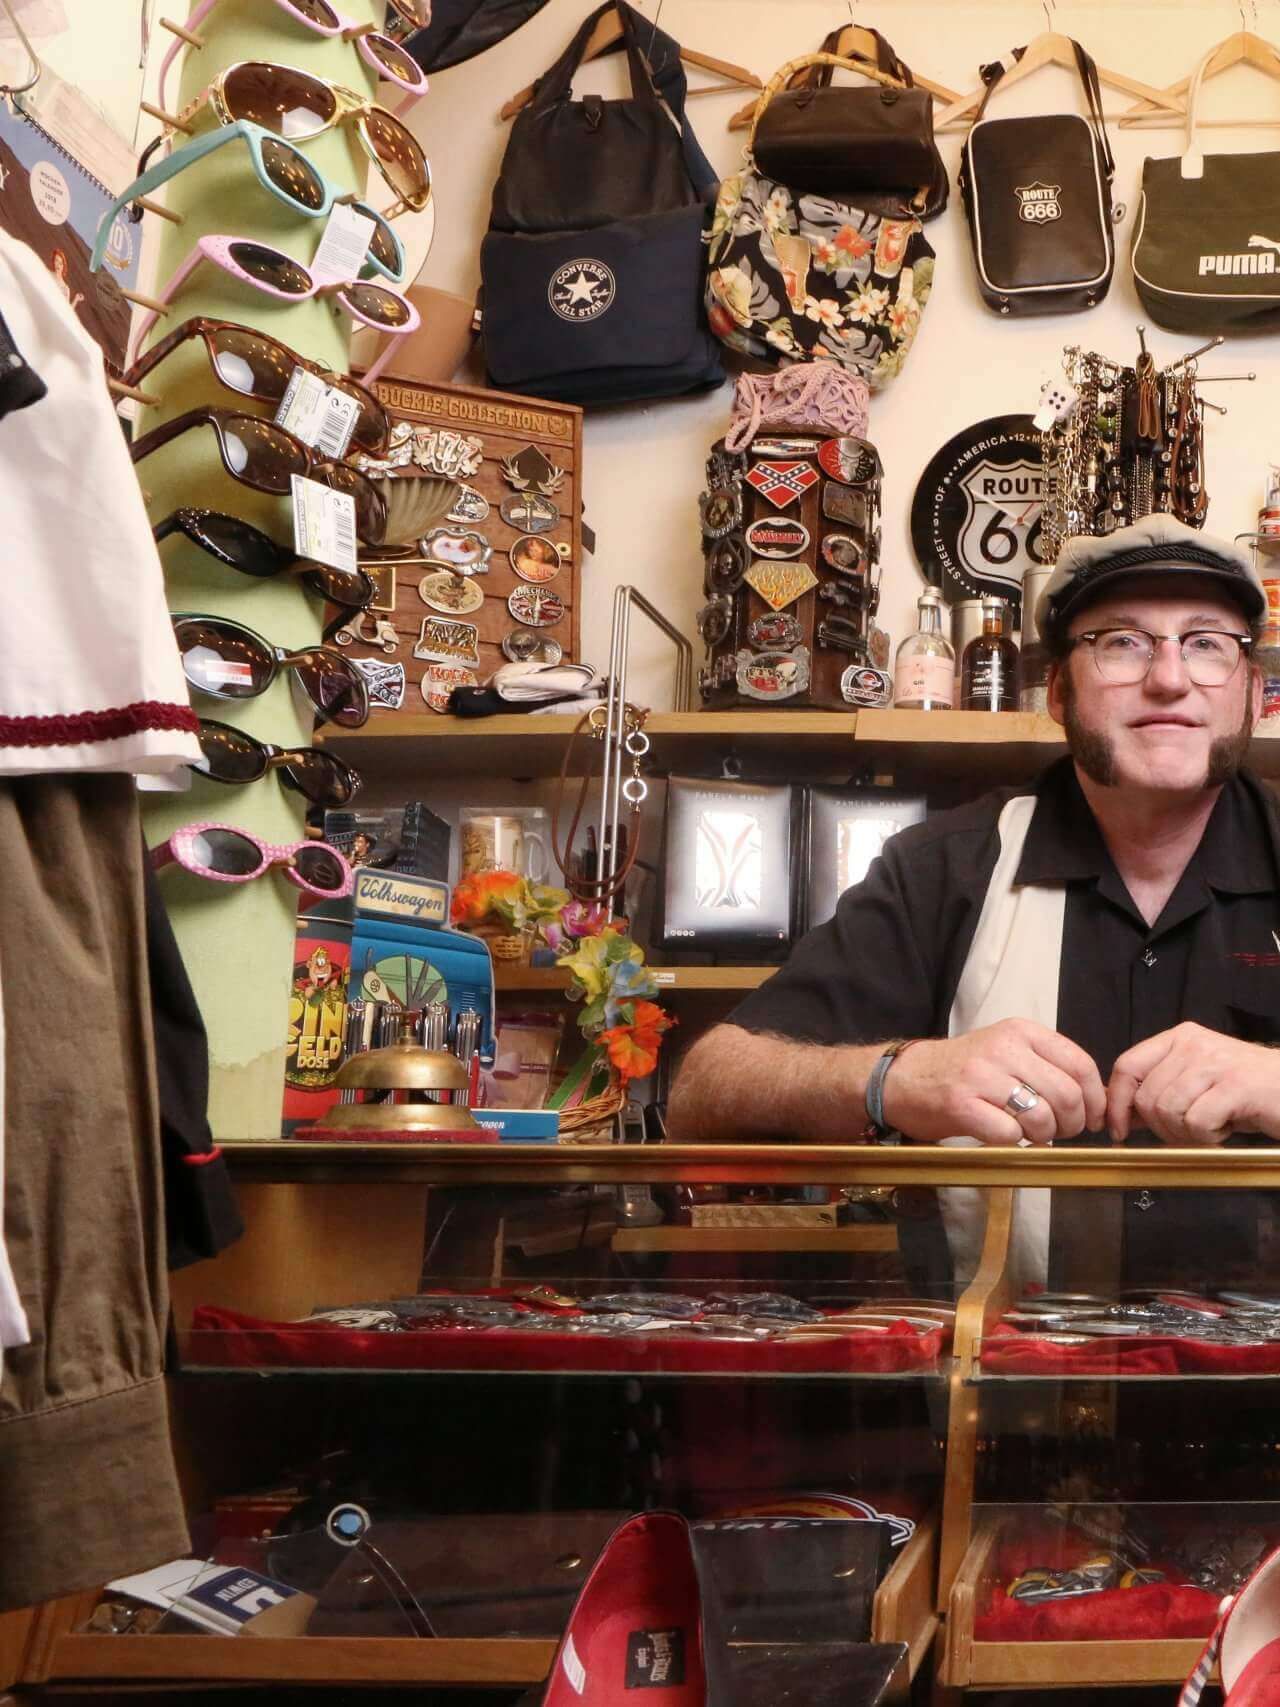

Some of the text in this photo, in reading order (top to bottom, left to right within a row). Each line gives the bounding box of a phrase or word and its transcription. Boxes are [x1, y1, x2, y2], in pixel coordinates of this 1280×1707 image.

[1022, 189, 1055, 201] ROUTE
[1024, 203, 1058, 220] 666
[1199, 252, 1275, 276] PUMA
[556, 263, 608, 285] CONVERSE
[559, 300, 604, 317] ALL STAR
[378, 384, 544, 432] BUCKLE COLLECTION
[1014, 433, 1025, 442] 12
[956, 434, 1008, 468] AMERICA
[934, 485, 948, 502] OF
[982, 477, 1058, 496] ROUTE
[932, 536, 962, 581] STREET
[429, 664, 472, 682] ROCK
[359, 877, 443, 914] Volkswagen
[297, 1055, 330, 1070] DOSE
